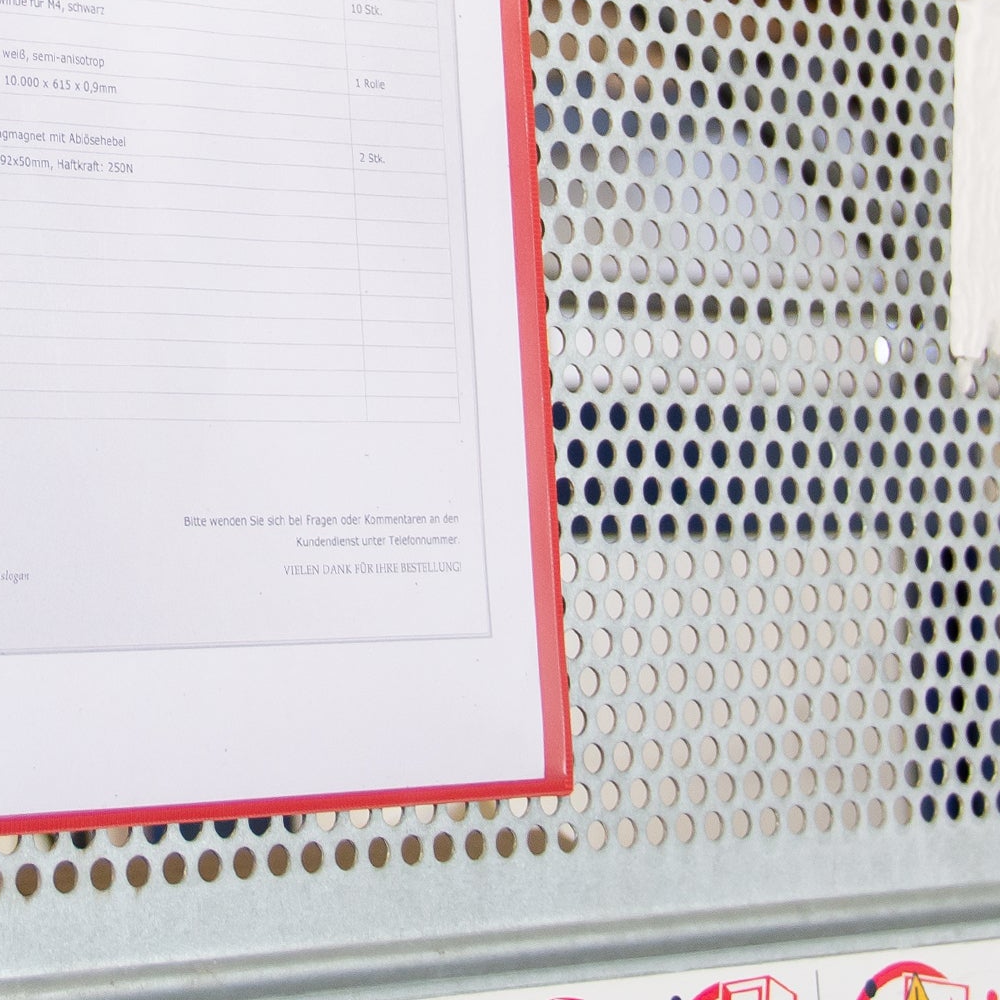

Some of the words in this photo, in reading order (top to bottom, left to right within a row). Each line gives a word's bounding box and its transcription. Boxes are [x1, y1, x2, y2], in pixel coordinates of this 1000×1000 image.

[68, 2, 105, 15] schwarz
[351, 4, 363, 15] 10
[365, 5, 383, 16] Stk.
[2, 49, 29, 62] weiß,
[32, 50, 104, 68] semi-anisotrop
[5, 75, 39, 88] 10.000
[43, 80, 48, 88] x
[53, 79, 71, 90] 615
[75, 82, 80, 91] x
[84, 81, 117, 94] 0,9mm
[356, 79, 360, 88] 1
[364, 79, 385, 90] Rolle
[50, 133, 66, 144] mit
[69, 133, 126, 147] Ablösehebel
[0, 155, 53, 171] 92x50mm,
[58, 159, 104, 173] Haftkraft:
[108, 162, 133, 174] 250N
[360, 153, 365, 162] 2
[368, 153, 385, 164] Stk.
[184, 516, 207, 527] Bitte
[210, 516, 247, 527] wenden
[250, 515, 264, 526] Sie
[267, 515, 285, 526] sich
[288, 515, 303, 526] bei
[306, 515, 338, 527] Fragen
[341, 514, 361, 525] oder
[364, 514, 427, 525] Kommentaren
[430, 515, 440, 524] an
[443, 513, 459, 524] den
[296, 536, 359, 547] Kundendienst
[362, 535, 386, 547] unter
[389, 534, 460, 546] Telefonnummer.
[284, 564, 320, 576] VIELEN
[323, 564, 352, 575] DANK
[355, 562, 374, 574] FÜR
[376, 563, 399, 574] IHRE
[401, 561, 462, 573] BESTELLUNG!
